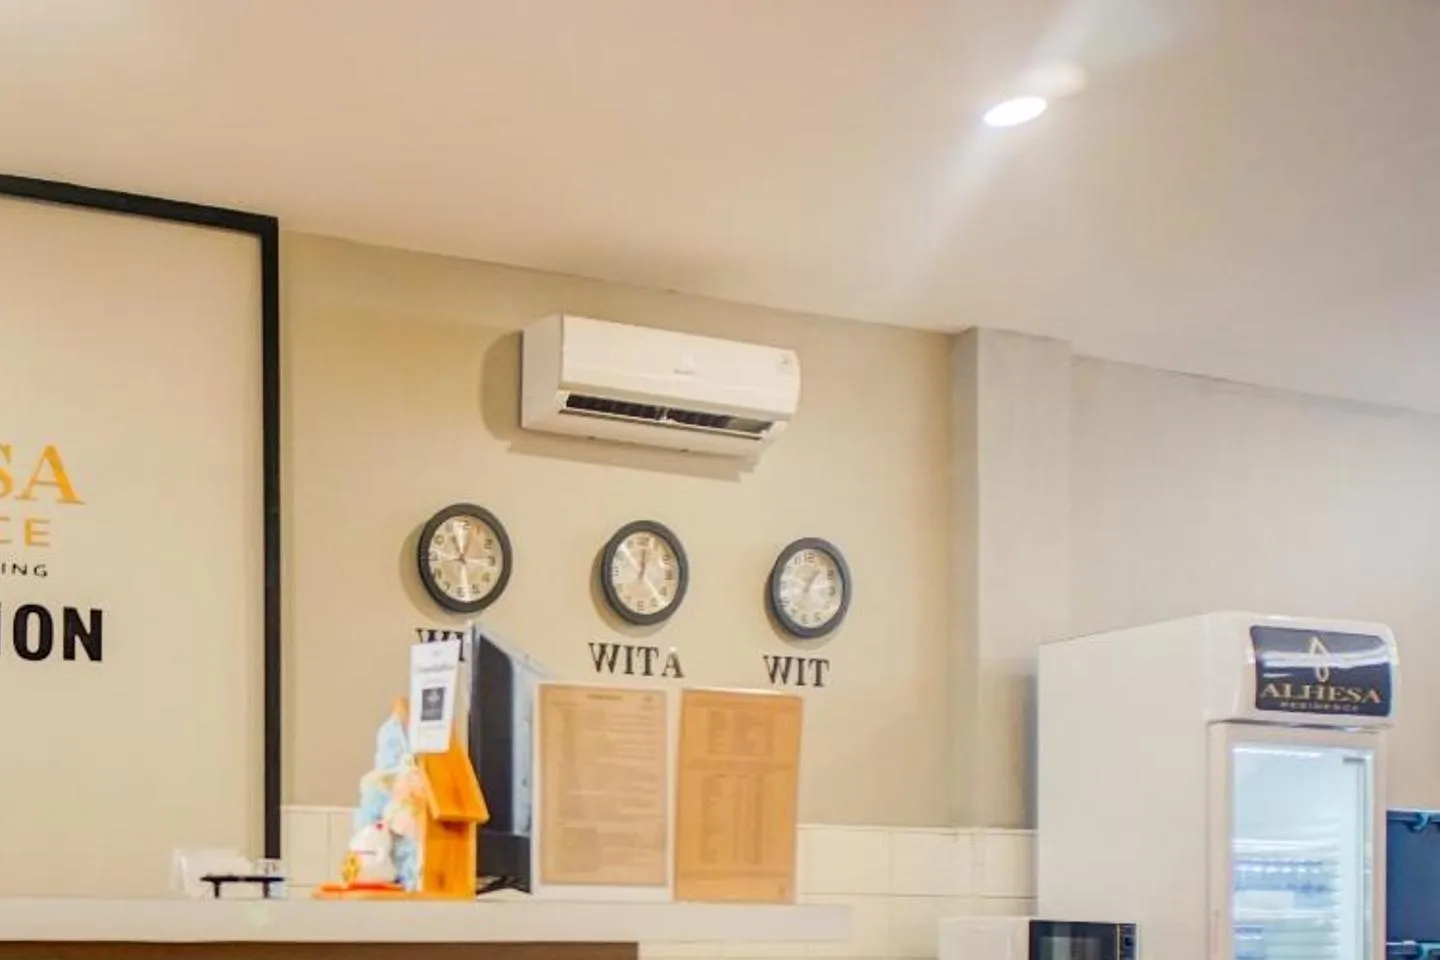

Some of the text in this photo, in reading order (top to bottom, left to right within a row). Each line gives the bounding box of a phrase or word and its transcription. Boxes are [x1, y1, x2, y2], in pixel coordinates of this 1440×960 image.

[588, 641, 686, 680] WITA
[762, 654, 831, 688] WIT
[1261, 682, 1383, 705] ALHESA
